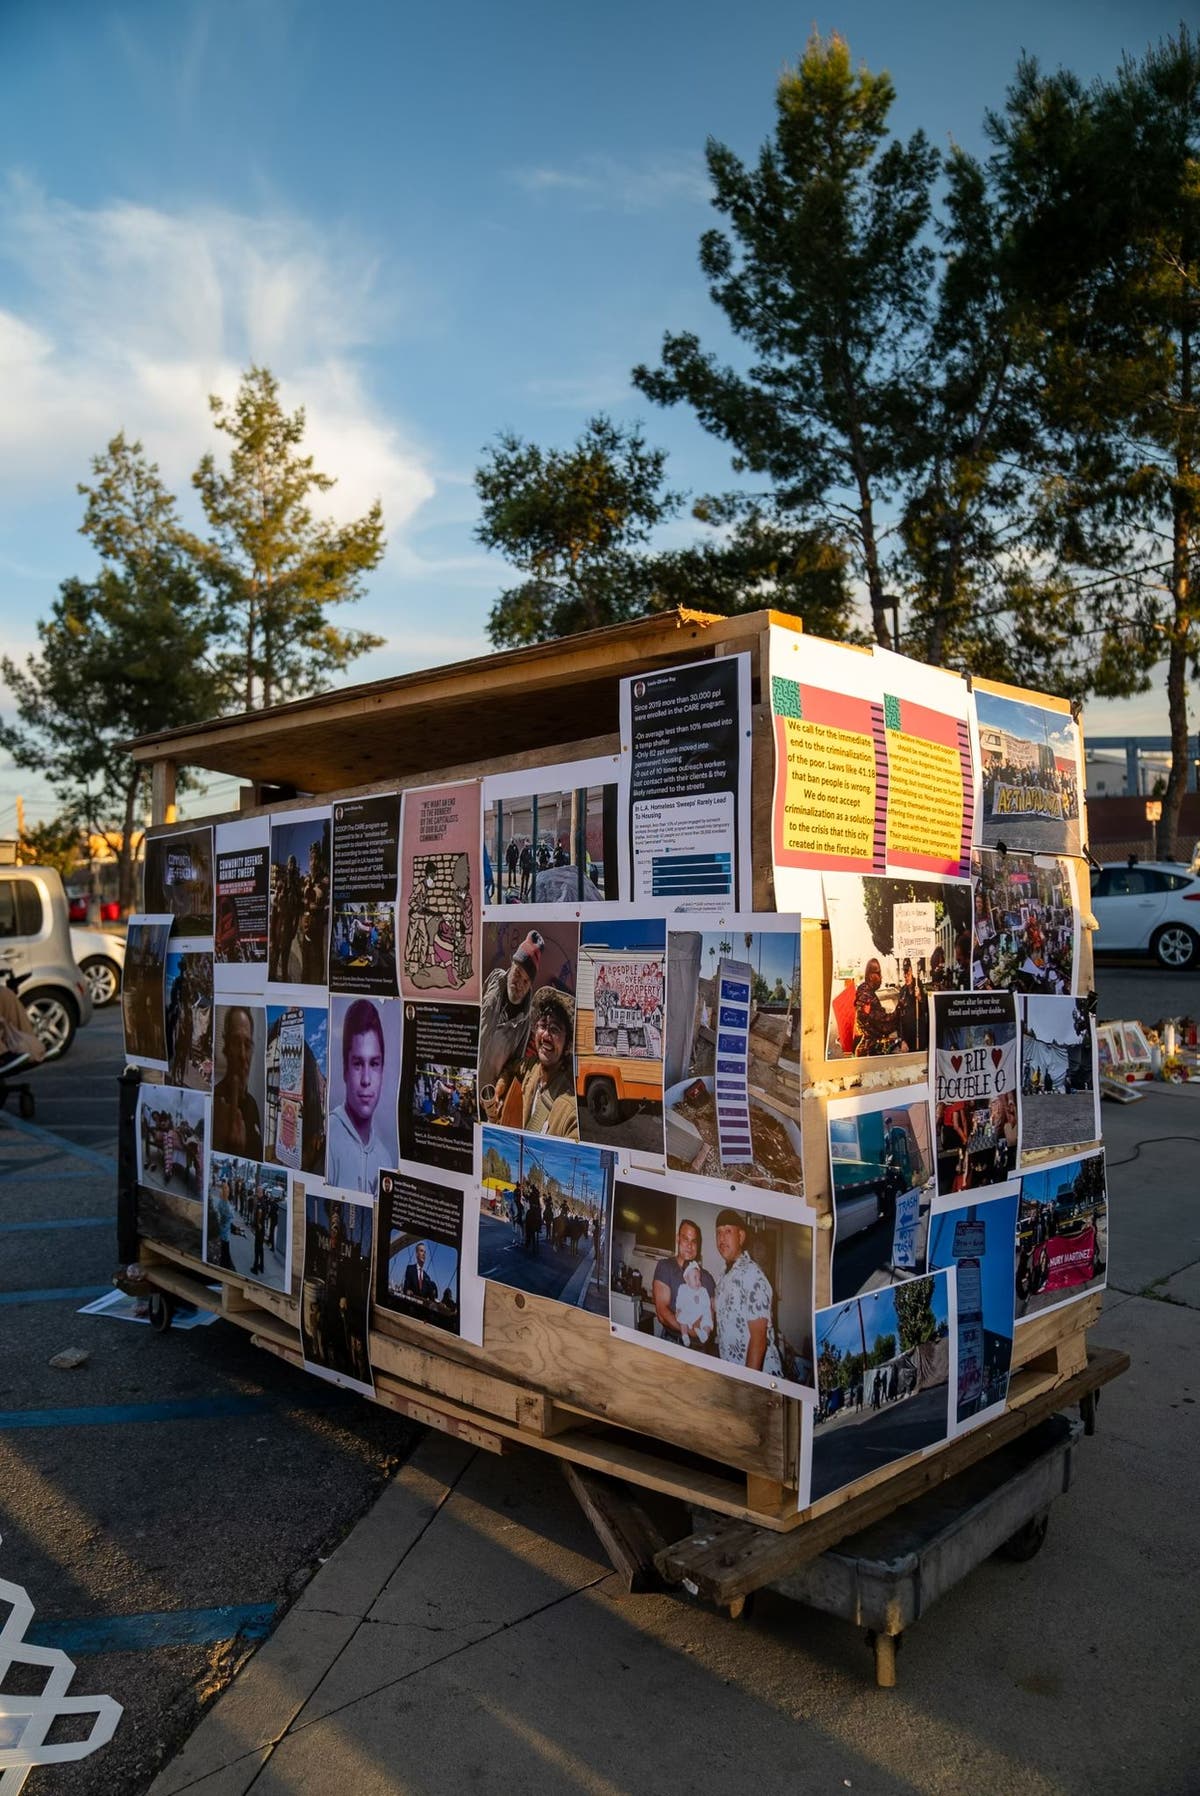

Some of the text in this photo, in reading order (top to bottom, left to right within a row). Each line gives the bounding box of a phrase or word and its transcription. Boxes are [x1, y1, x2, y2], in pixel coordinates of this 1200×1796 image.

[649, 700, 661, 709] 2019
[690, 691, 711, 701] 30,000
[712, 689, 720, 698] ppl
[647, 709, 667, 718] enrolled
[684, 703, 699, 712] CARE
[702, 720, 720, 728] moved
[788, 721, 871, 747] We call for the immediate
[679, 744, 697, 752] moved
[791, 739, 872, 762] end to the criminalization
[635, 758, 660, 769] permanent
[679, 763, 703, 771] outreach
[797, 756, 808, 765] the
[810, 760, 826, 768] poor.
[828, 762, 844, 772] Laws
[846, 765, 857, 775] like
[858, 768, 875, 778] 41.18
[644, 777, 662, 785] contact
[792, 772, 806, 782] that
[808, 775, 820, 784] ban
[822, 779, 843, 789] people
[845, 781, 849, 789] is
[804, 791, 816, 799] We
[817, 793, 825, 801] do
[840, 798, 860, 808] accept
[785, 805, 835, 819] criminalization
[850, 815, 874, 824] solution
[435, 824, 446, 832] BLACK
[790, 822, 869, 841] to the crisis that this city
[789, 841, 868, 856] created in the first place.
[220, 854, 263, 869] COMMUNITY DEFENSE
[238, 867, 255, 879] SWEEPS
[613, 965, 638, 975] PEOPLE
[625, 985, 660, 994] PROPERTY
[964, 1049, 987, 1074] RIP
[936, 1069, 1006, 1100] DOUBLE O
[1064, 1248, 1090, 1263] MARTINEZ
